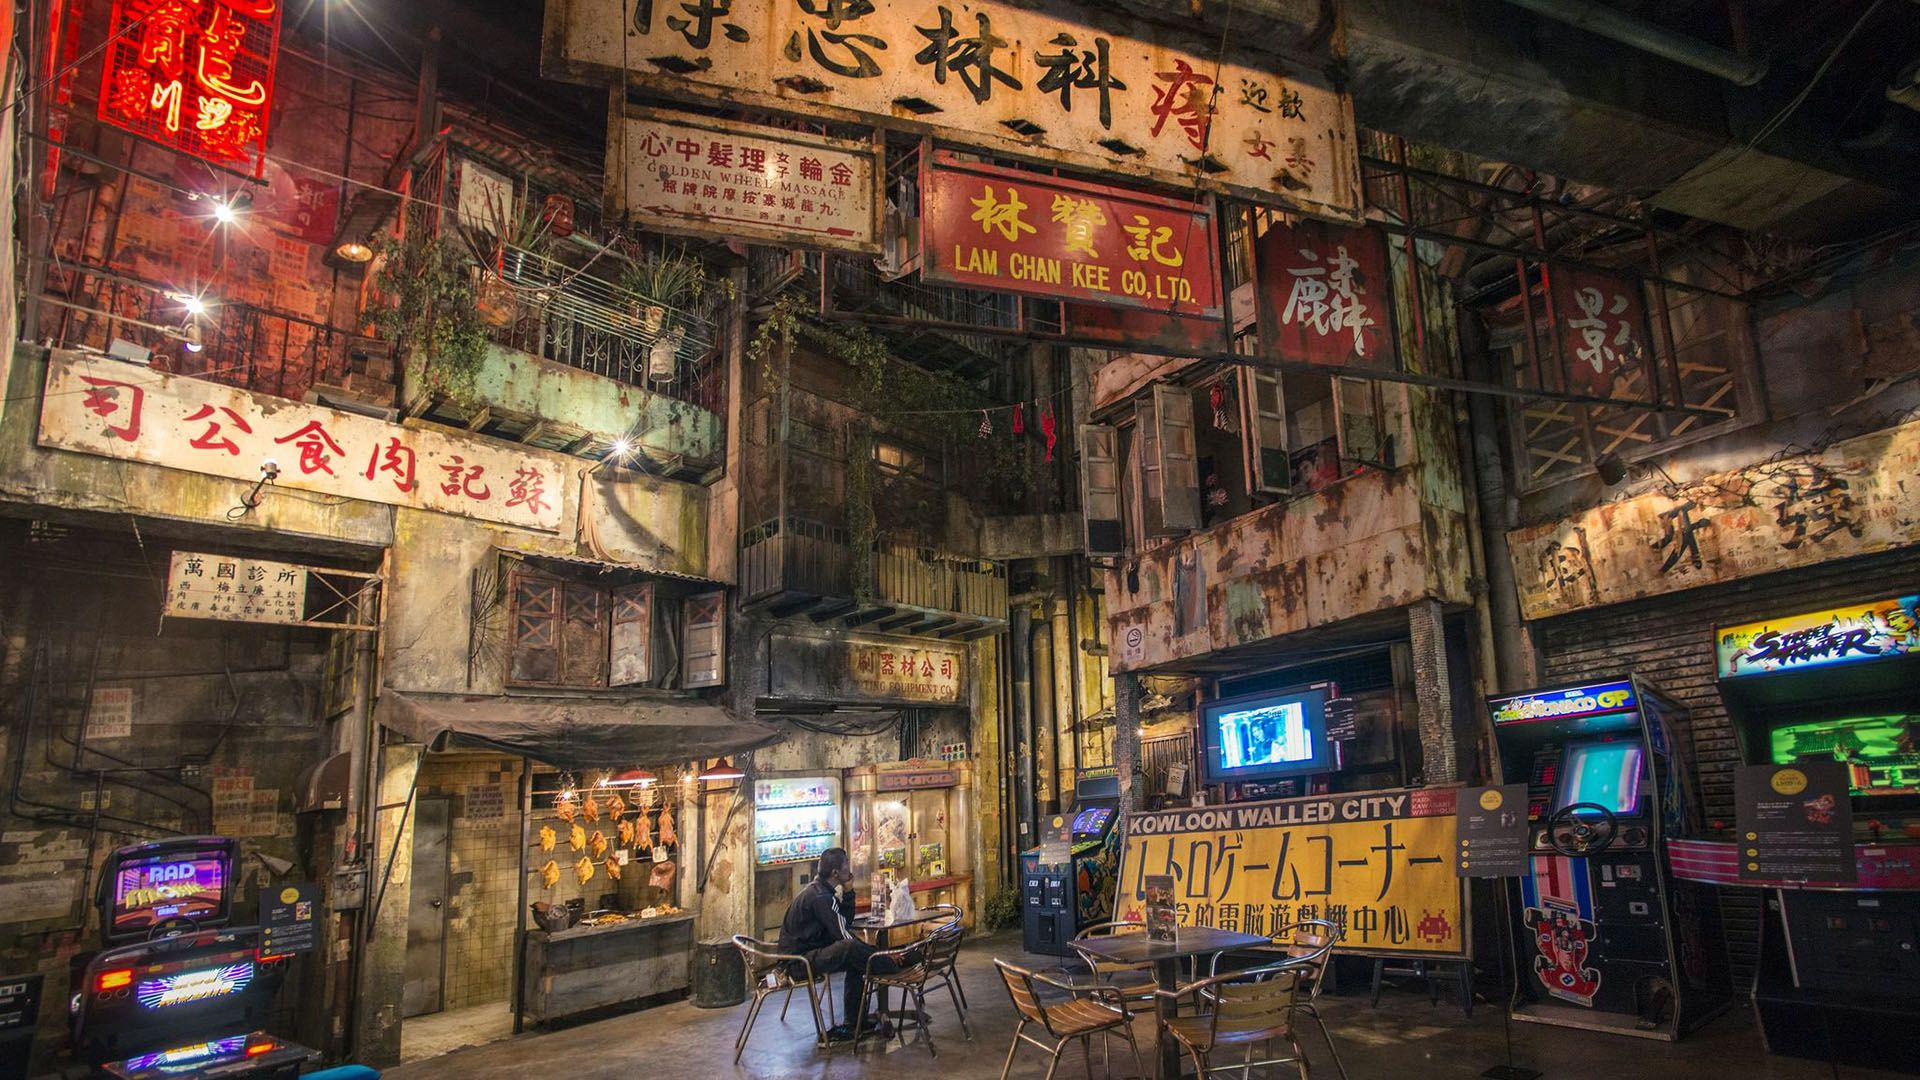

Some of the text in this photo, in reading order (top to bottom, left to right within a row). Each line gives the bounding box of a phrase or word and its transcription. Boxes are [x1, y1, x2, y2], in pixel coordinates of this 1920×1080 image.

[647, 162, 847, 201] GOLDEN WHEEL MASSAGE
[955, 245, 998, 277] LAM
[1009, 252, 1062, 285] CHAN
[1072, 261, 1110, 290] KEE
[79, 374, 552, 516] 蘇記肉食公司
[184, 558, 298, 587] 萬國診所
[889, 681, 938, 696] EQUIPMENT
[1597, 689, 1630, 709] GP
[1129, 795, 1407, 836] KOWLOON WALLED CITY
[149, 863, 196, 883] RAD
[1136, 822, 1444, 903] レトロゲームコーナー
